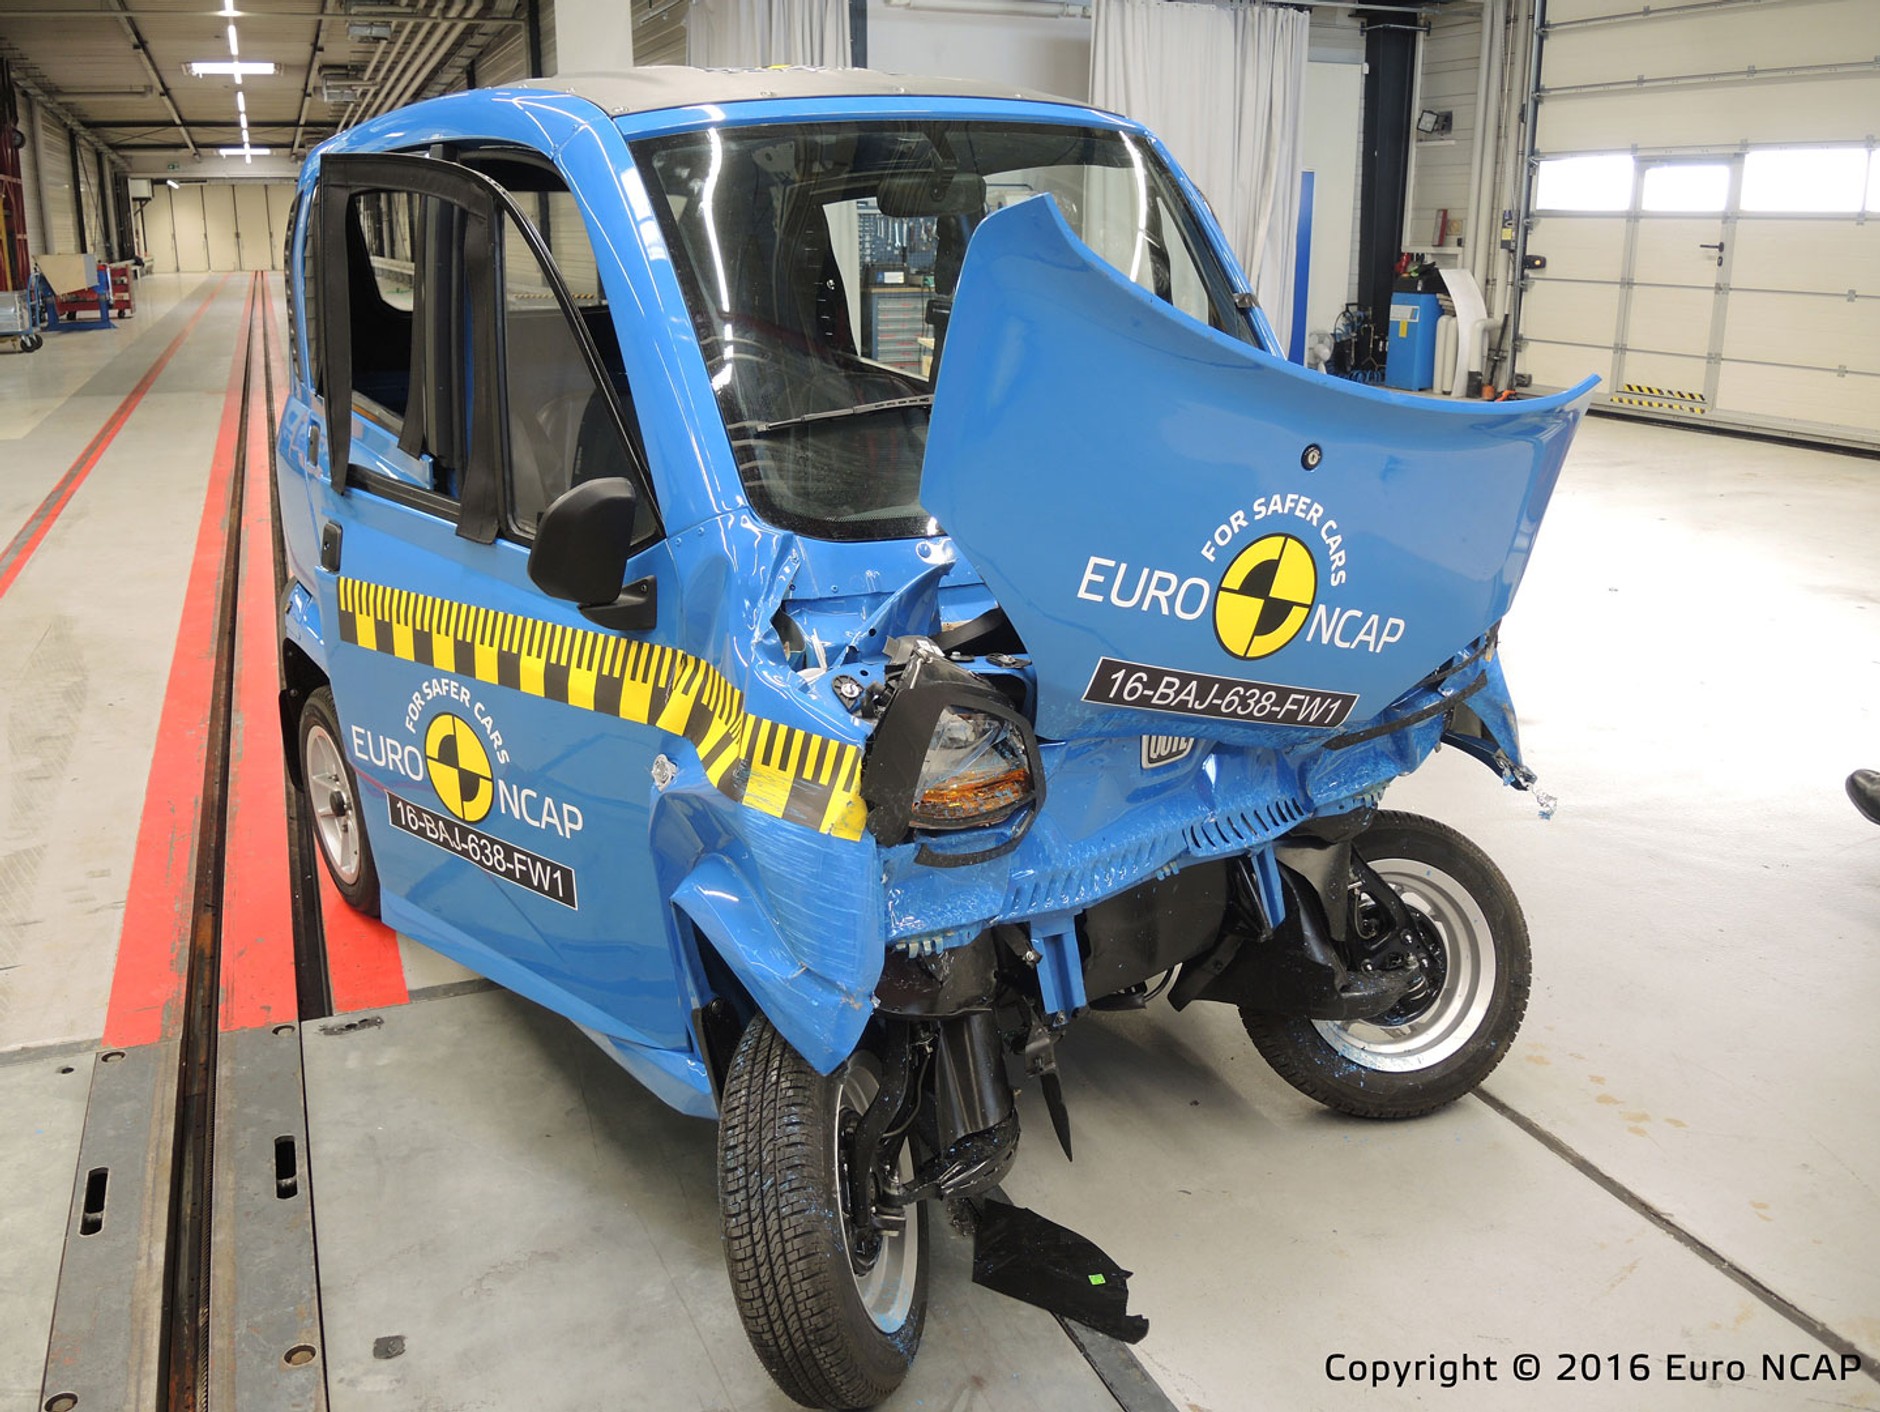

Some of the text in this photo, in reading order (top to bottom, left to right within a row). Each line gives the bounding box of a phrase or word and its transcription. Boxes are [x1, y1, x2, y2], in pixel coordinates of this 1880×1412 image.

[1200, 494, 1346, 587] FOR SAFER CARS
[1077, 556, 1405, 653] EURO NCAP
[405, 678, 510, 764] FOR SAFER CARS
[1107, 668, 1343, 725] 16-BAJ-638-FW1
[351, 725, 583, 839] EURO NCAP
[397, 801, 564, 897] 16-BAJ-638-FW1
